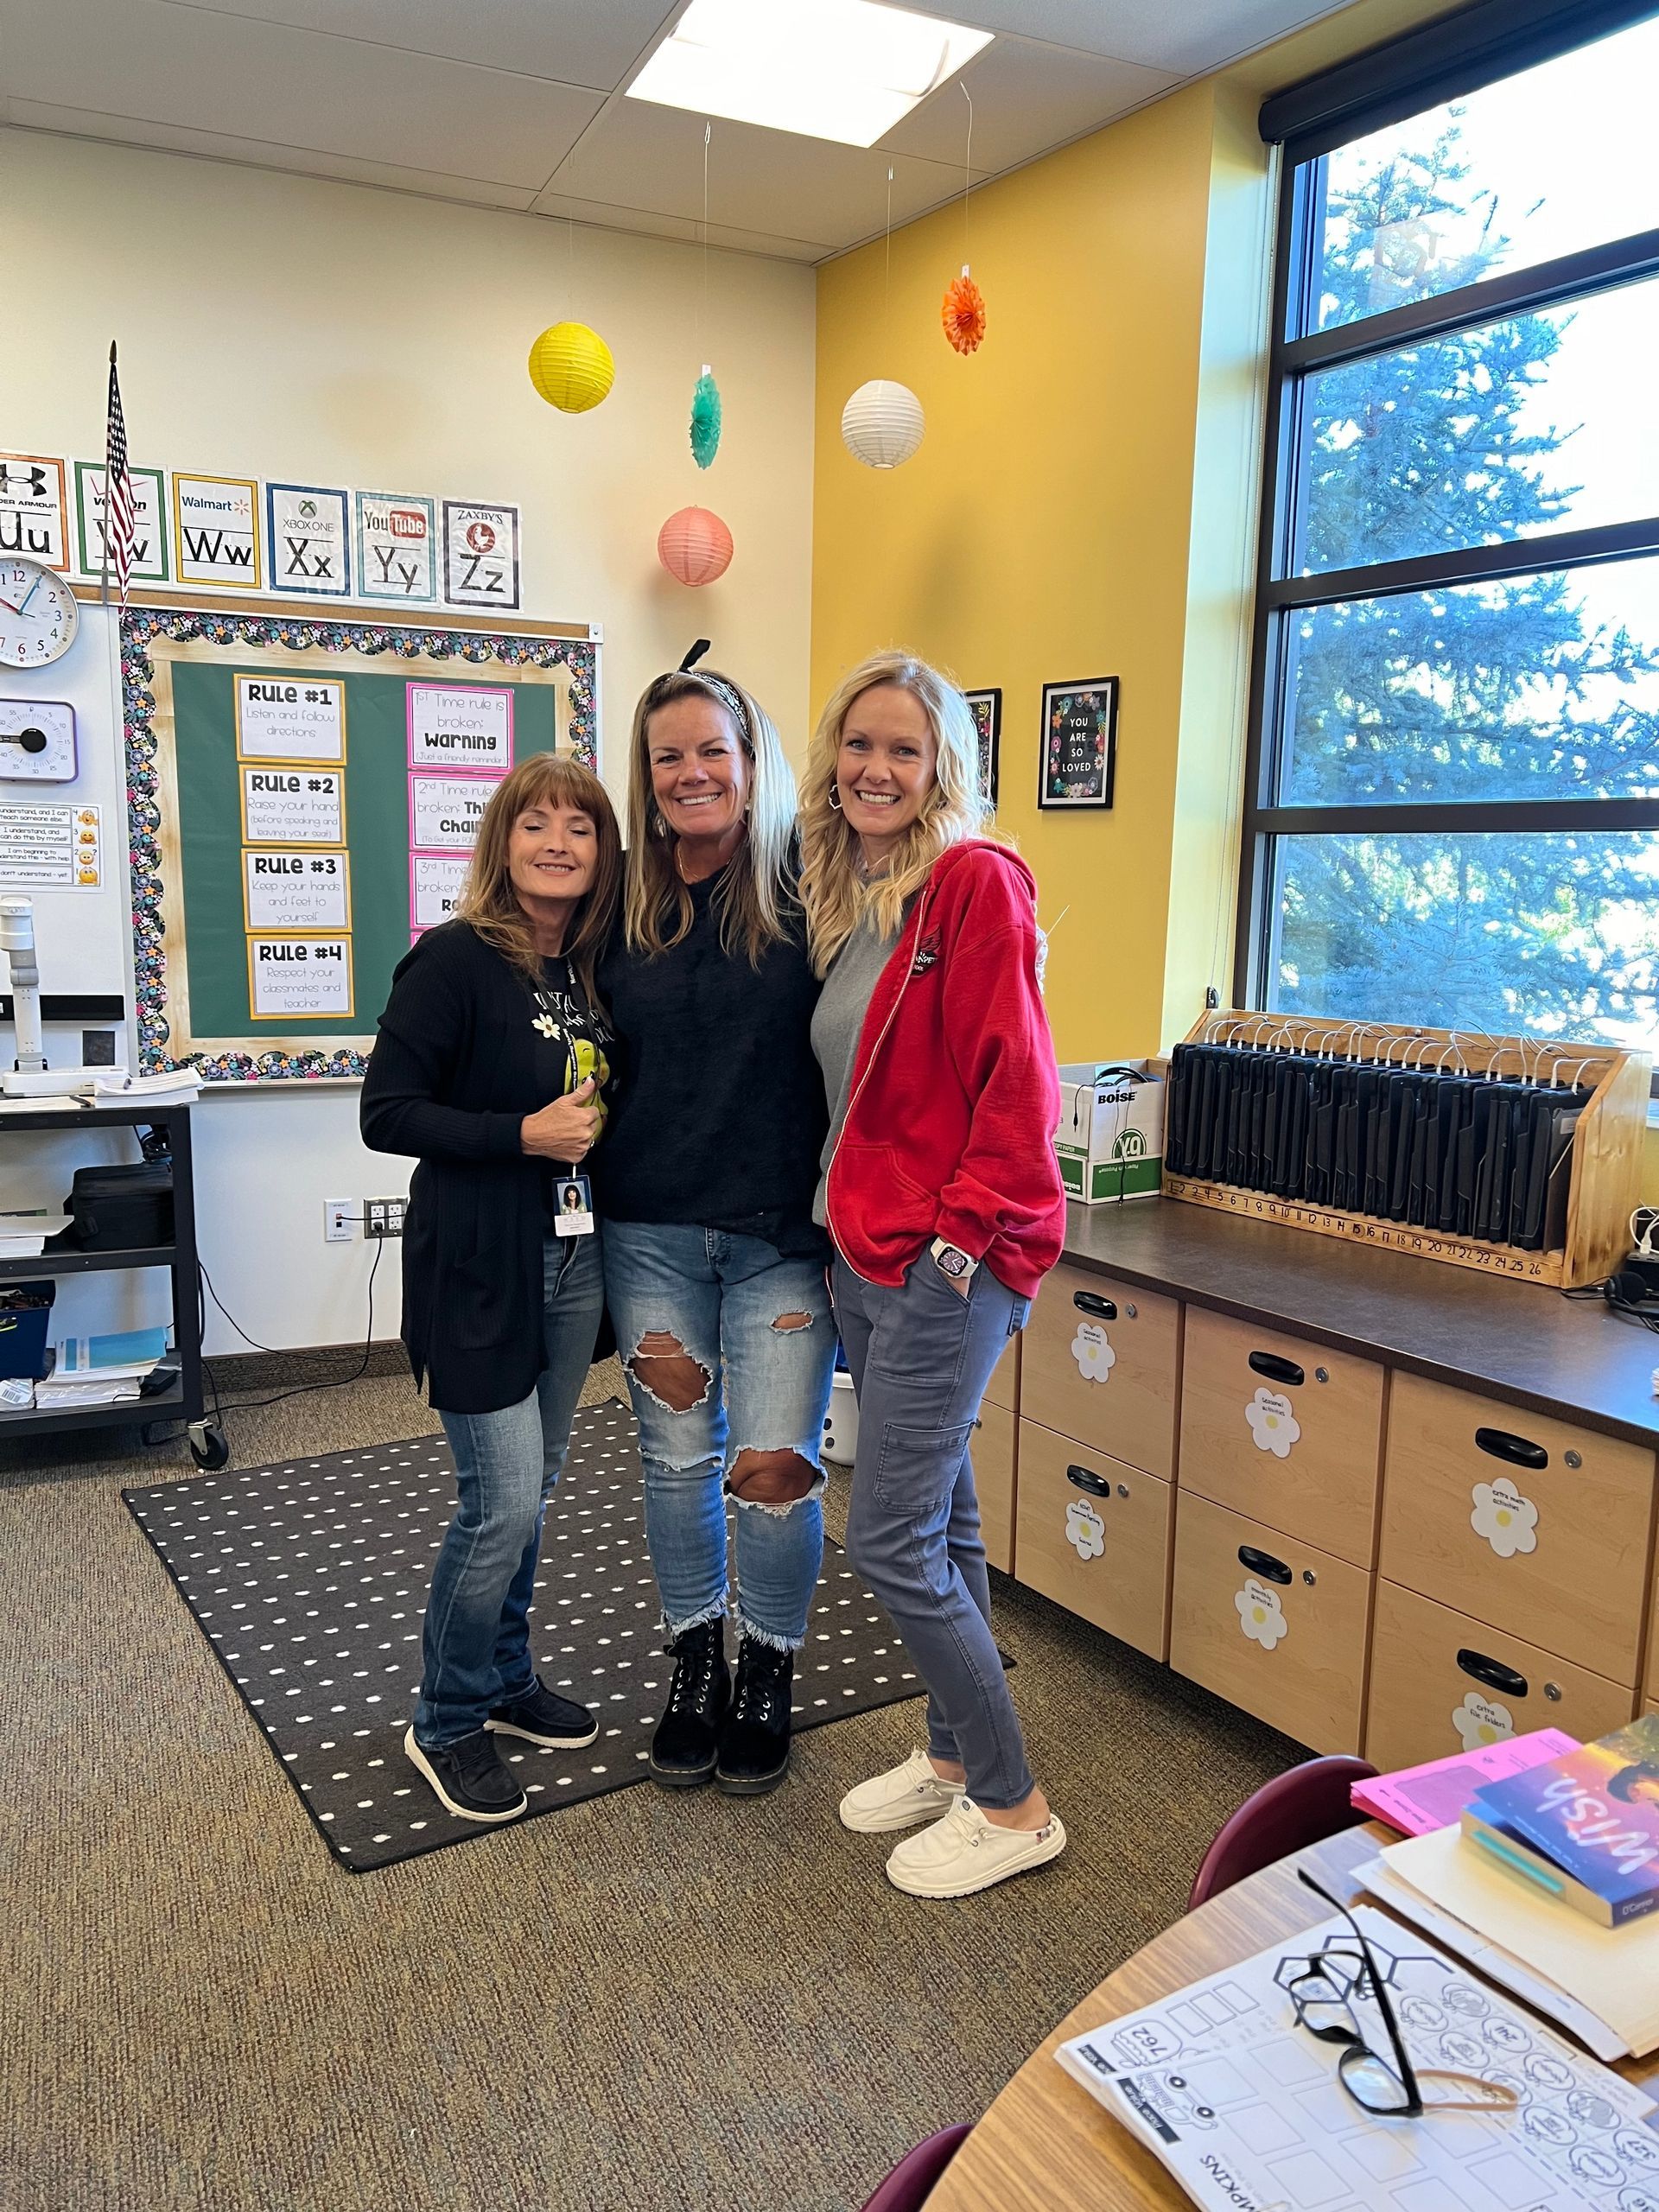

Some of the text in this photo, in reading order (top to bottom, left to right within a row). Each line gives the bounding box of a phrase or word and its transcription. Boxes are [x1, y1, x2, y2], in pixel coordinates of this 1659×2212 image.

[17, 500, 57, 510] ARMOUR
[181, 495, 232, 512] Walmart
[458, 509, 504, 524] ZAXBY'S
[283, 518, 334, 533] XBOX ONE
[13, 569, 26, 582] 12
[48, 591, 57, 603] 2
[54, 610, 62, 621] 3
[50, 628, 59, 639] 4
[17, 643, 26, 654] 6
[37, 639, 45, 651] 5
[305, 689, 332, 705] #1
[435, 693, 465, 709] Time
[469, 698, 492, 710] rule
[495, 699, 505, 711] is
[246, 708, 335, 722] Listen and follow
[437, 715, 484, 728] broken:
[1070, 718, 1088, 727] YOU
[266, 726, 316, 737] directions
[1070, 733, 1086, 741] ARE
[444, 753, 470, 763] friendly
[1071, 748, 1084, 757] SO
[1062, 763, 1090, 772] LOVED
[308, 778, 334, 794] #2
[418, 781, 492, 797] 2nd Time rule
[248, 797, 340, 814] Raise your hand
[417, 801, 461, 814] broken:
[284, 817, 321, 827] speaking
[257, 828, 286, 839] leaving
[289, 830, 308, 839] your
[311, 859, 336, 874] #3
[420, 862, 436, 874] 3rd
[251, 880, 340, 893] Keep your hands
[269, 896, 327, 906] and feet to
[276, 912, 320, 925] yourself
[315, 945, 341, 961] #4
[267, 967, 335, 980] Respect your
[263, 982, 341, 993] classmates and
[283, 998, 321, 1008] teacher
[1179, 1183, 1185, 1193] 2
[1192, 1187, 1198, 1197] 3
[1205, 1189, 1210, 1199] 4
[1217, 1192, 1224, 1201] 5
[1230, 1195, 1236, 1205] 6
[1243, 1198, 1249, 1208] 7
[1255, 1201, 1262, 1212] 8
[1269, 1204, 1275, 1215] 9
[1281, 1207, 1289, 1217] 10
[1296, 1211, 1301, 1221] 11
[1309, 1213, 1317, 1224] 12
[1323, 1217, 1331, 1227] 13
[1337, 1221, 1344, 1231] 14
[1352, 1223, 1361, 1234] 15
[1366, 1225, 1376, 1236] 16
[1396, 1234, 1406, 1245] 18
[1411, 1237, 1421, 1250] 19
[1427, 1239, 1441, 1253] 20
[1446, 1245, 1456, 1255] 21
[1459, 1248, 1473, 1260] 22
[1476, 1251, 1490, 1264] 23
[1495, 1256, 1506, 1269] 24
[1510, 1260, 1523, 1272] 25
[1529, 1262, 1541, 1275] 26
[1477, 1705, 1495, 1716] extra
[1470, 1708, 1506, 1729] file folders
[1132, 2026, 1168, 2056] 762
